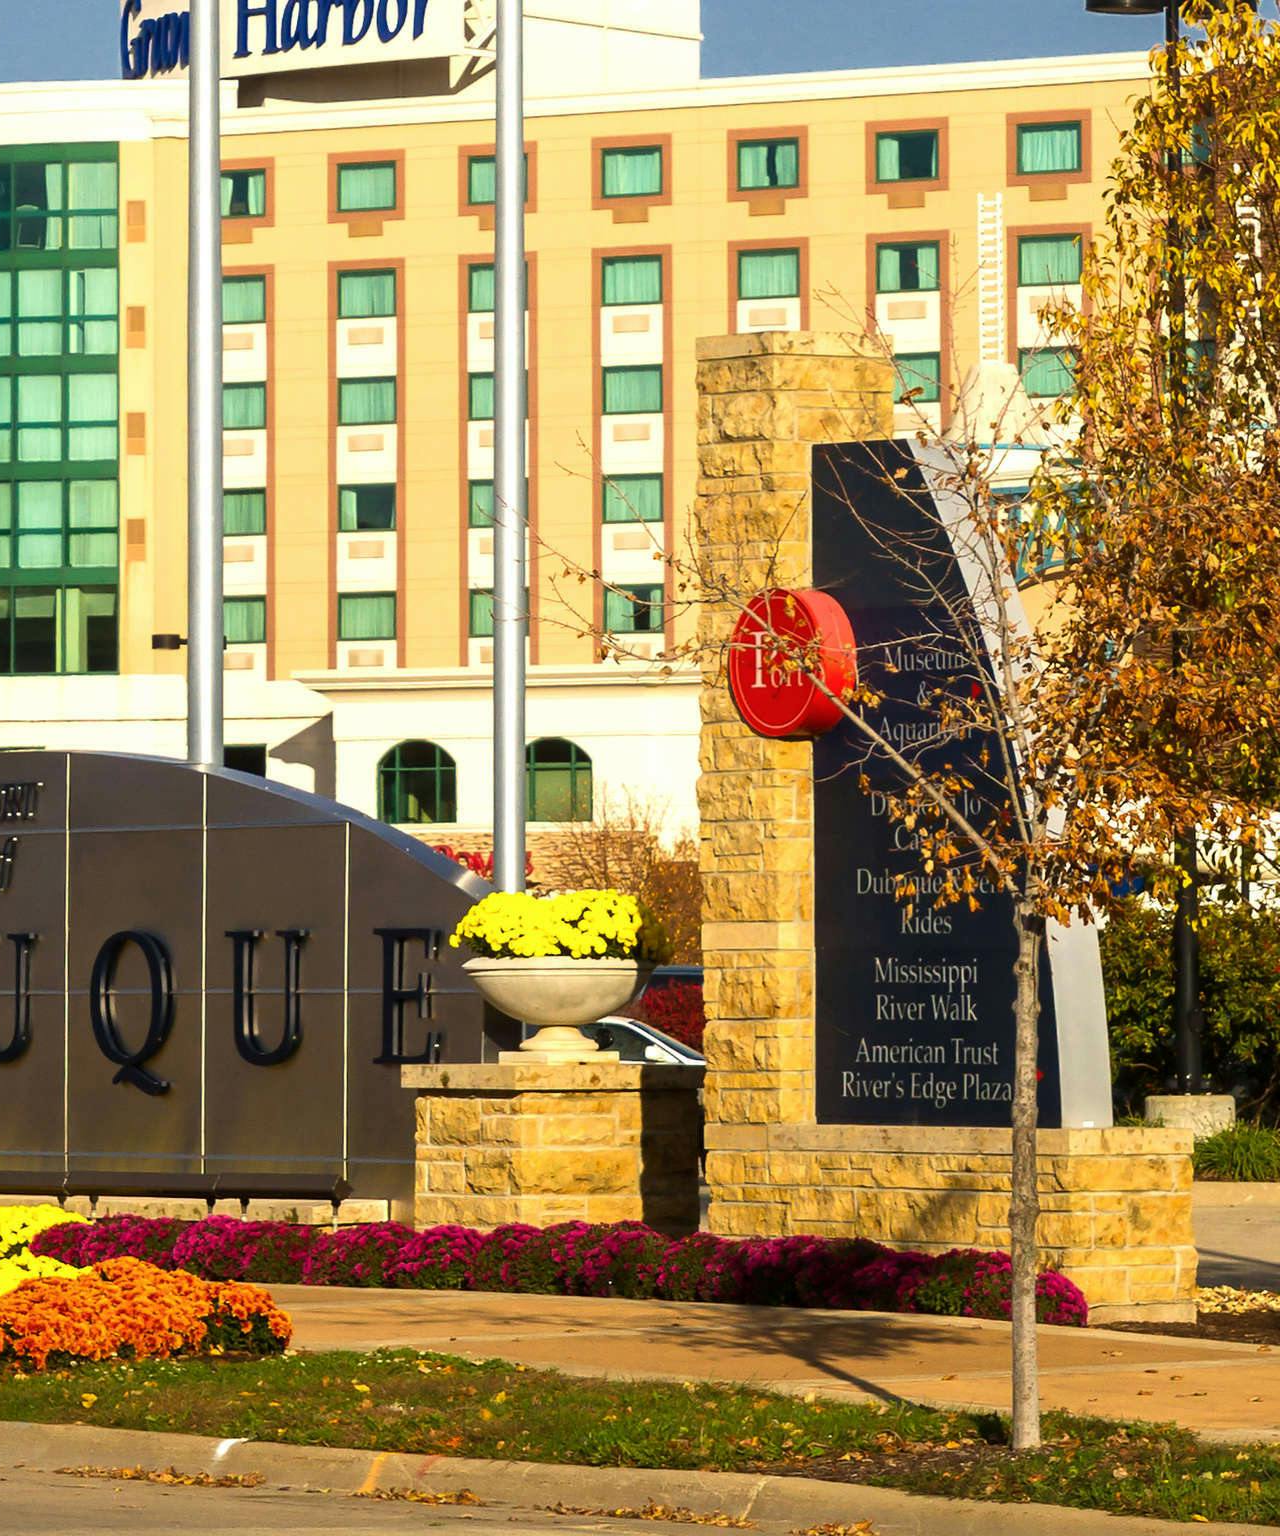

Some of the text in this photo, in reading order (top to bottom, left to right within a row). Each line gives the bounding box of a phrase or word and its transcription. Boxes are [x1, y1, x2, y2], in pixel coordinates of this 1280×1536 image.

[233, 0, 427, 59] Harbor
[883, 646, 966, 672] Museum
[900, 907, 953, 935] Rides
[874, 957, 978, 993] Mississippi
[876, 994, 978, 1022] River Walk
[855, 1037, 999, 1066] American Trust
[841, 1070, 1013, 1109] River's Edge Plaza
